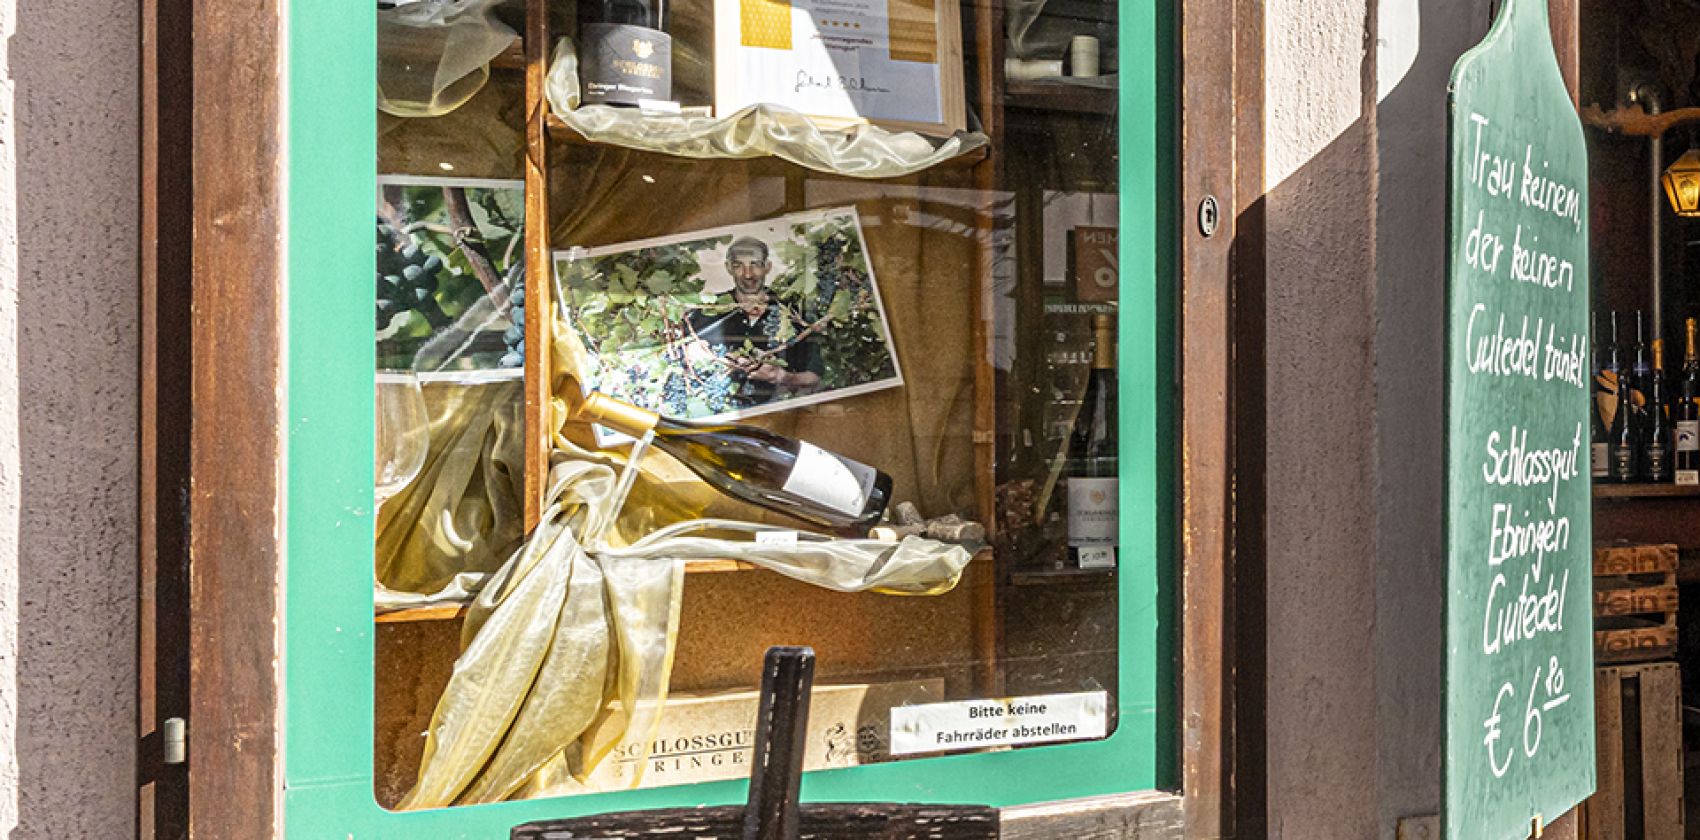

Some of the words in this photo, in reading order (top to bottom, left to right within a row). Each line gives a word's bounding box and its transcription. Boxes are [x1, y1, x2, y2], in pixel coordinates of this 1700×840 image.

[1470, 112, 1515, 199] Trau
[1520, 144, 1582, 233] keinem,
[1465, 209, 1504, 275] der
[1510, 224, 1574, 292] keinen
[1544, 322, 1586, 389] trinkt
[1482, 421, 1582, 515] Schlossgut
[1488, 503, 1570, 583] Ebringen
[1483, 568, 1570, 655] Gutedel
[936, 727, 1008, 744] Fahrräder
[1012, 723, 1077, 738] abstellen
[969, 705, 1003, 718] Bitte
[1008, 703, 1047, 716] keine
[1483, 681, 1515, 779] €
